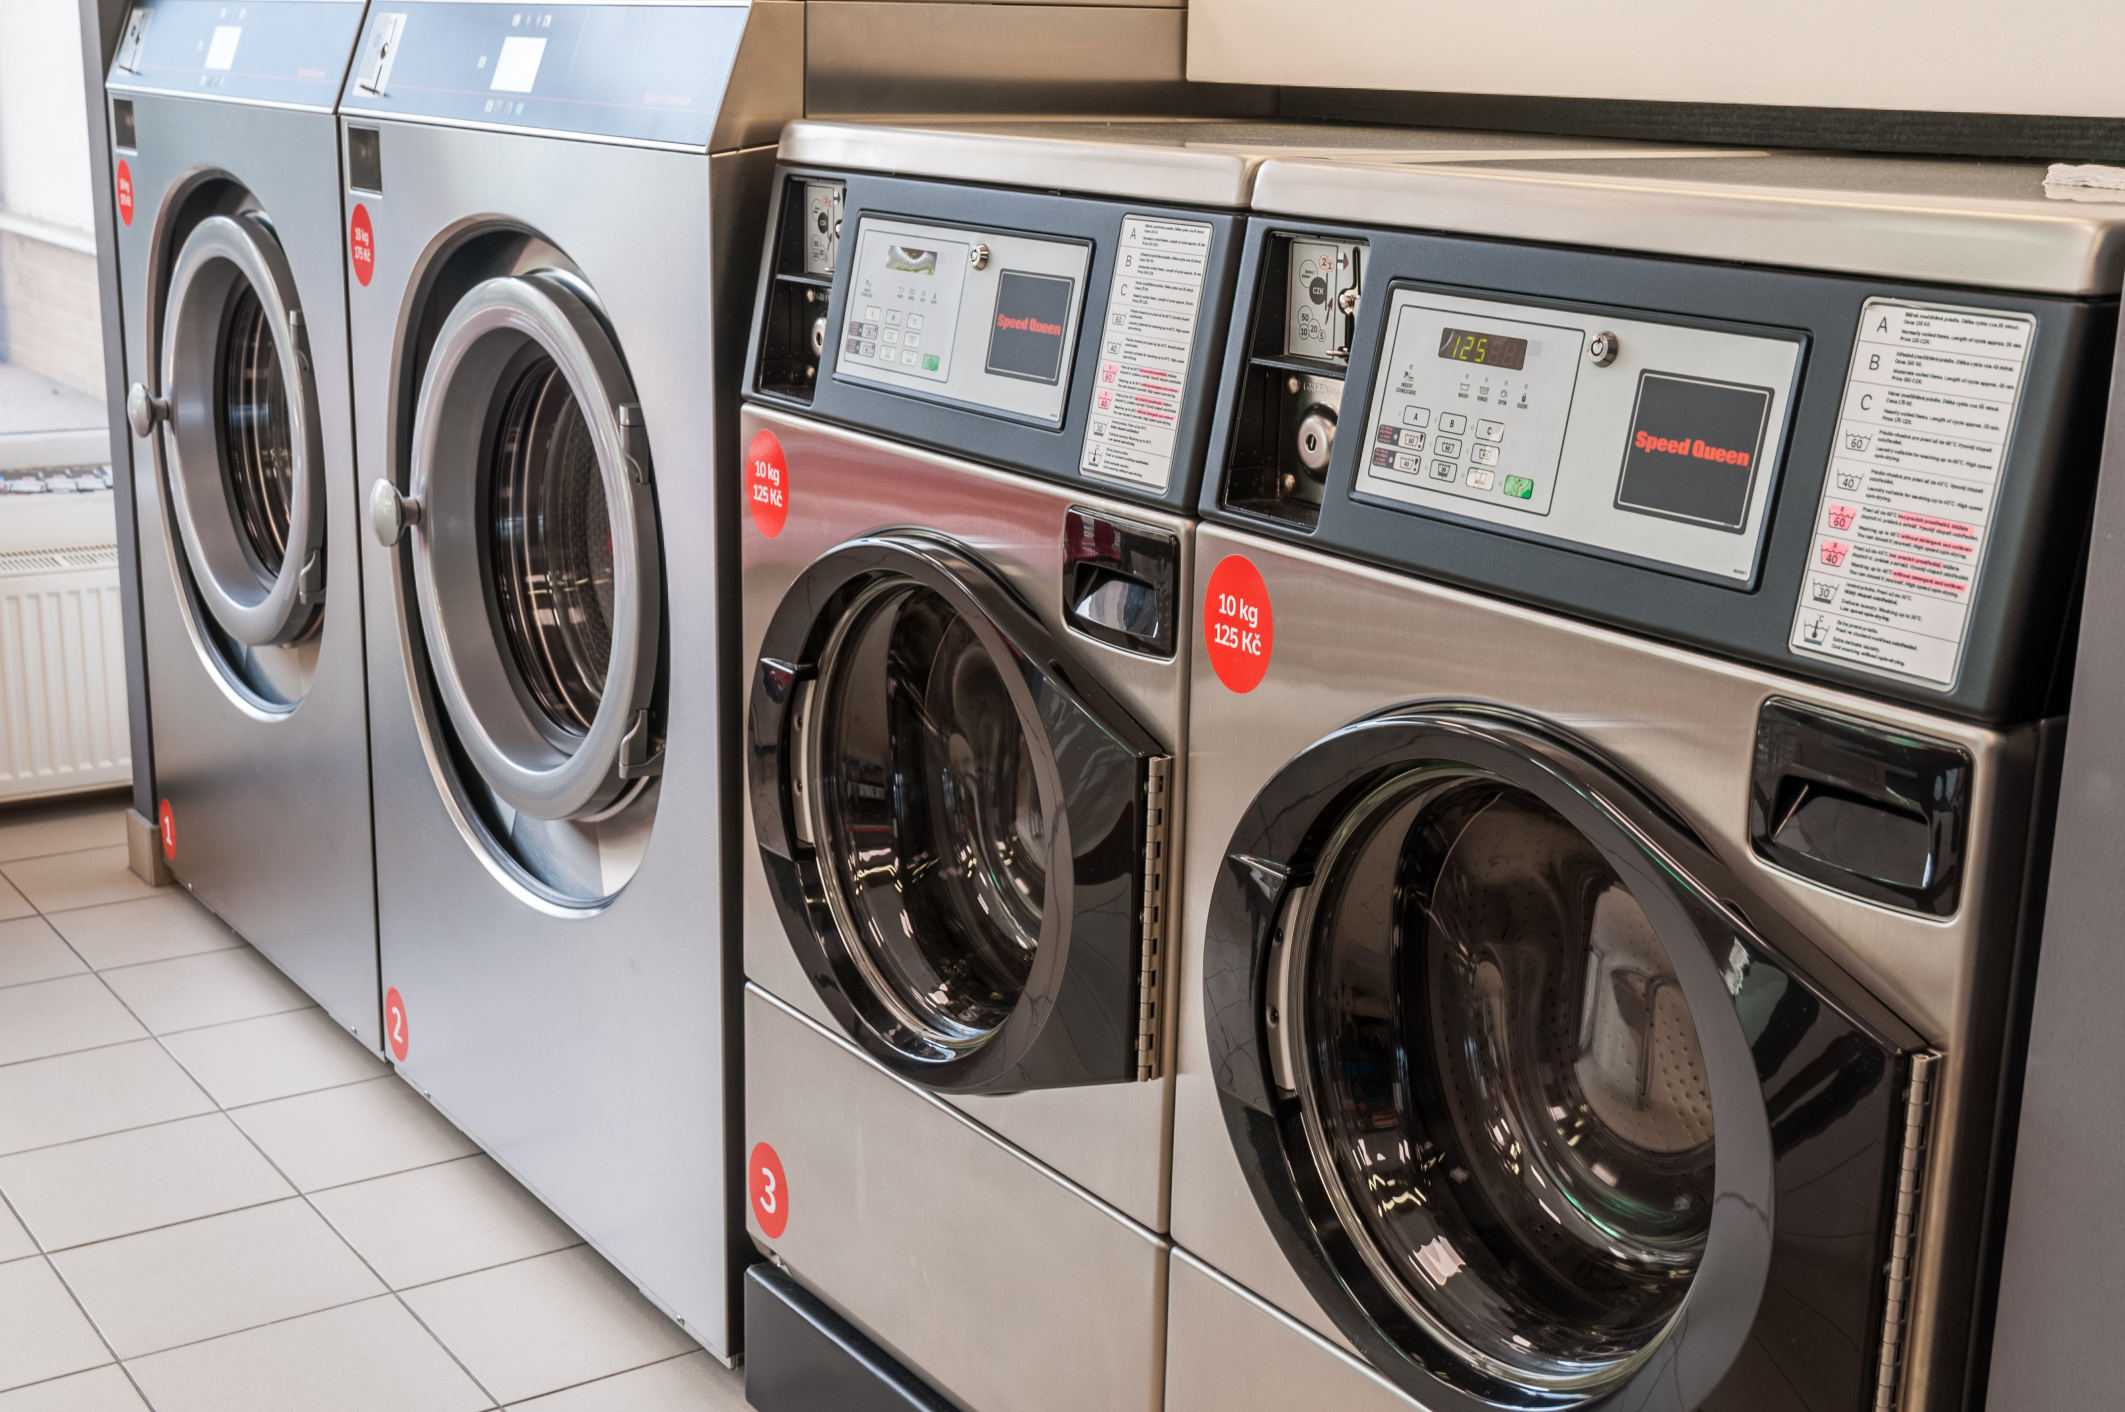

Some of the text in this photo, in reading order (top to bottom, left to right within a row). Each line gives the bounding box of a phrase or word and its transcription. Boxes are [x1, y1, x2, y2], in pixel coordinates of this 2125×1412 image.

[362, 228, 369, 247] kg
[1130, 228, 1136, 239] A
[1126, 255, 1132, 267] B
[1322, 258, 1327, 266] 2
[1121, 284, 1128, 296] C
[1312, 287, 1324, 295] CZK
[997, 314, 1061, 336] Speed Queen
[1877, 317, 1888, 333] A
[1452, 336, 1488, 362] 125
[1869, 354, 1881, 370] B
[1860, 394, 1872, 411] C
[1413, 413, 1418, 421] A
[1450, 420, 1454, 428] B
[1487, 427, 1492, 435] C
[1635, 430, 1750, 467] Speed Queen
[1850, 439, 1863, 449] 60
[755, 460, 780, 486] 10 kg
[1842, 478, 1854, 488] 40
[753, 484, 783, 507] 125 Kč
[1833, 517, 1846, 528] 60
[1825, 554, 1838, 564] 40
[1818, 588, 1830, 598] 30
[1219, 593, 1258, 628] 10 kg
[1214, 623, 1262, 656] 125 Kč
[164, 816, 173, 846] 1
[392, 1006, 403, 1044] 2
[760, 1167, 776, 1214] 3
